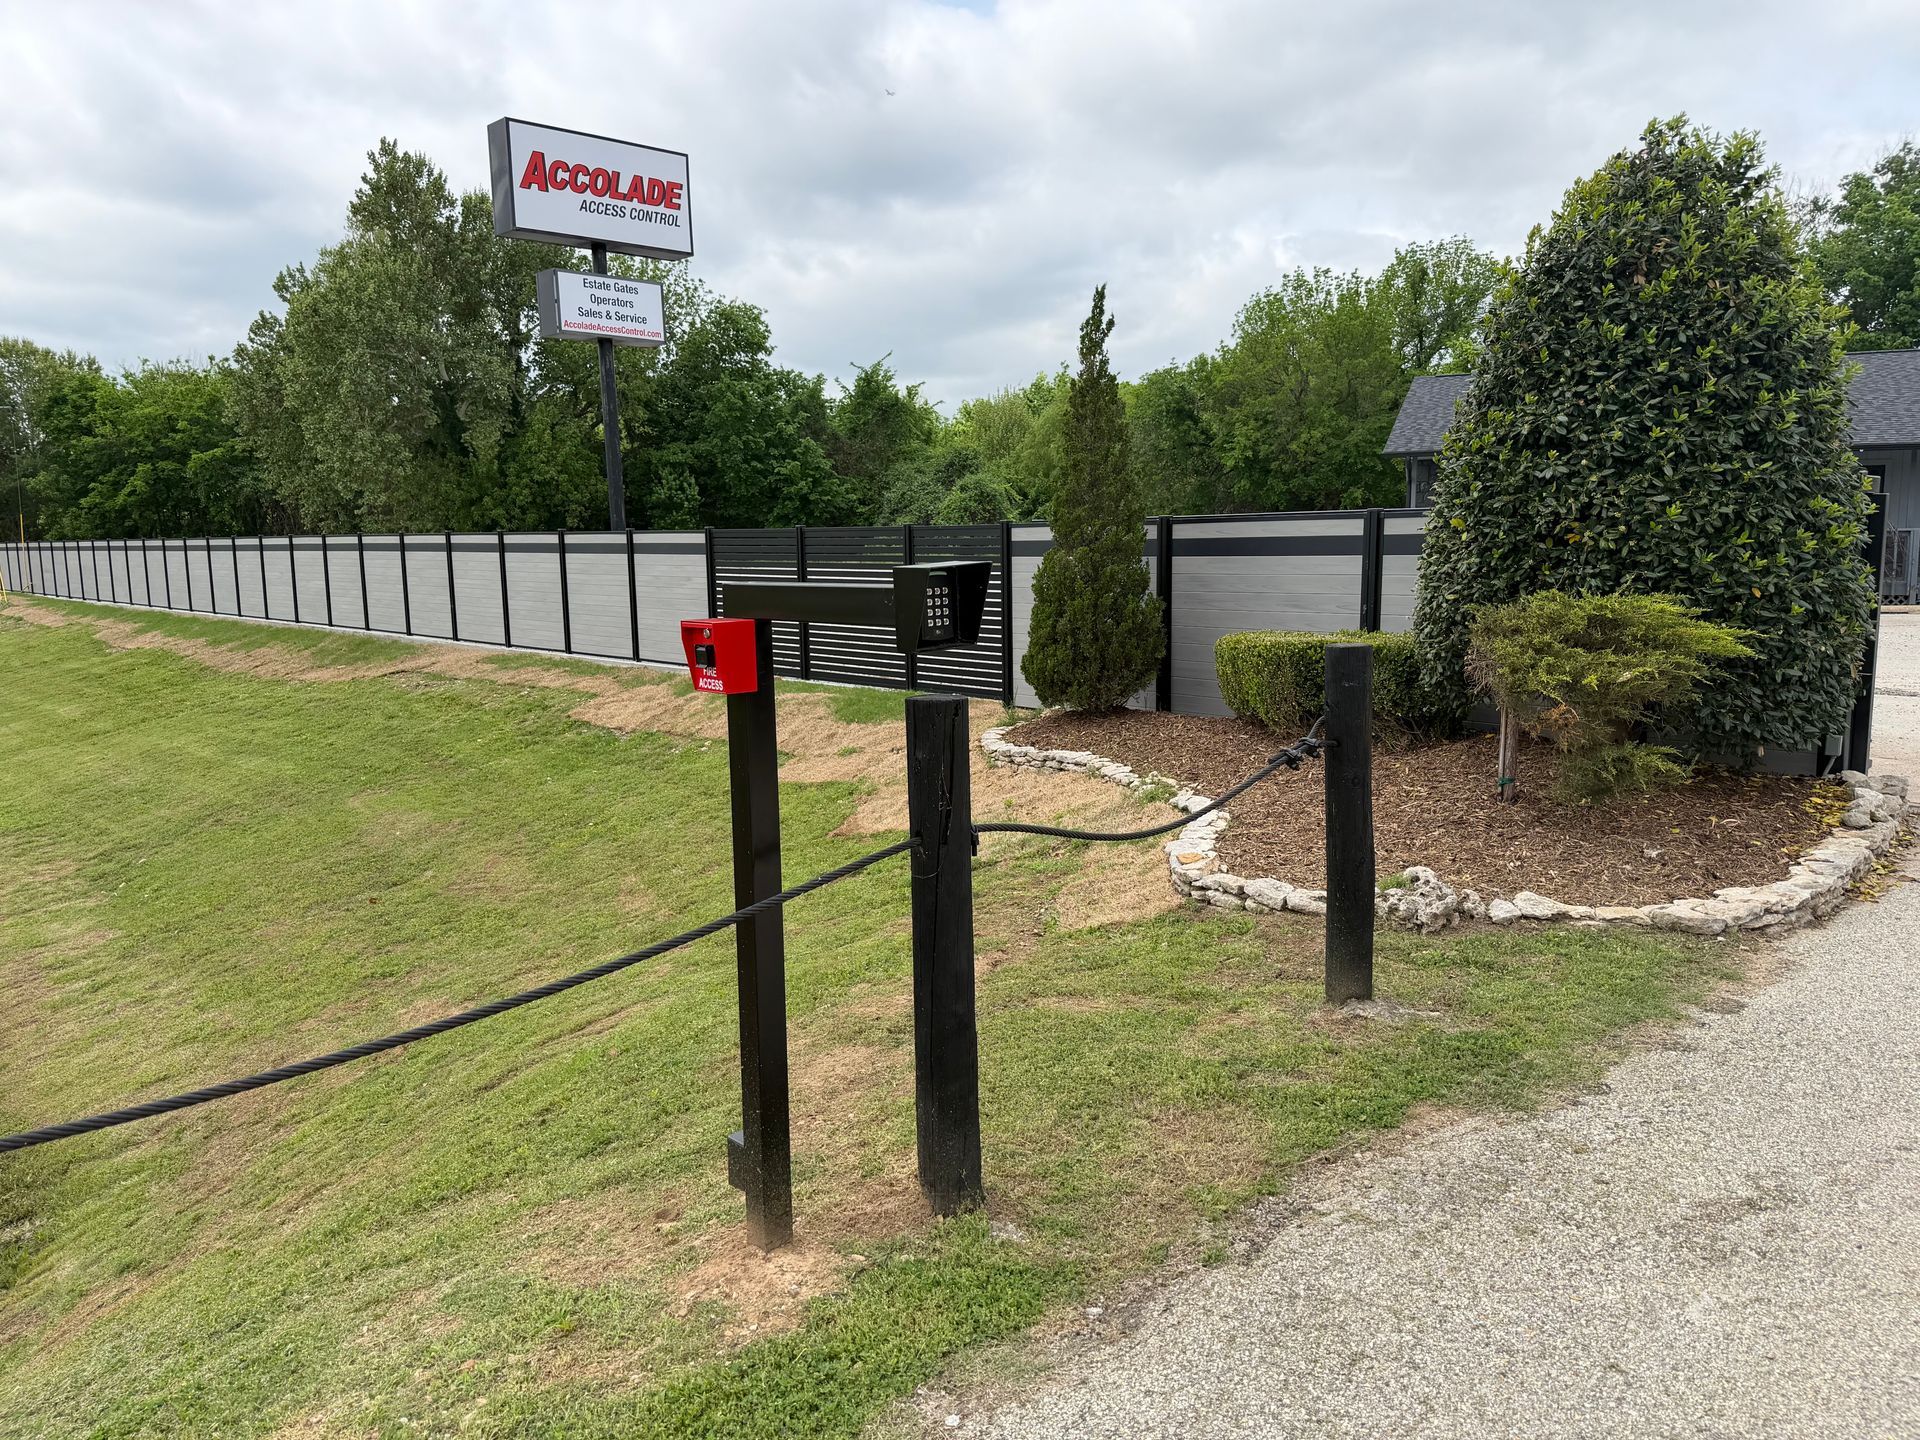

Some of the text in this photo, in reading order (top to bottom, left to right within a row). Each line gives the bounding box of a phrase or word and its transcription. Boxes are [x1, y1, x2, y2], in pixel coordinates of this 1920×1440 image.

[520, 151, 683, 210] ACCOLADE
[579, 200, 680, 228] ACCESS CONTROL
[583, 278, 639, 295] Estate Gates
[590, 294, 634, 308] Operators
[578, 307, 648, 325] Sales & Service
[563, 320, 662, 338] AccoladeAccessControl.com
[703, 667, 717, 677] FIRE
[699, 678, 723, 691] ACCESS
